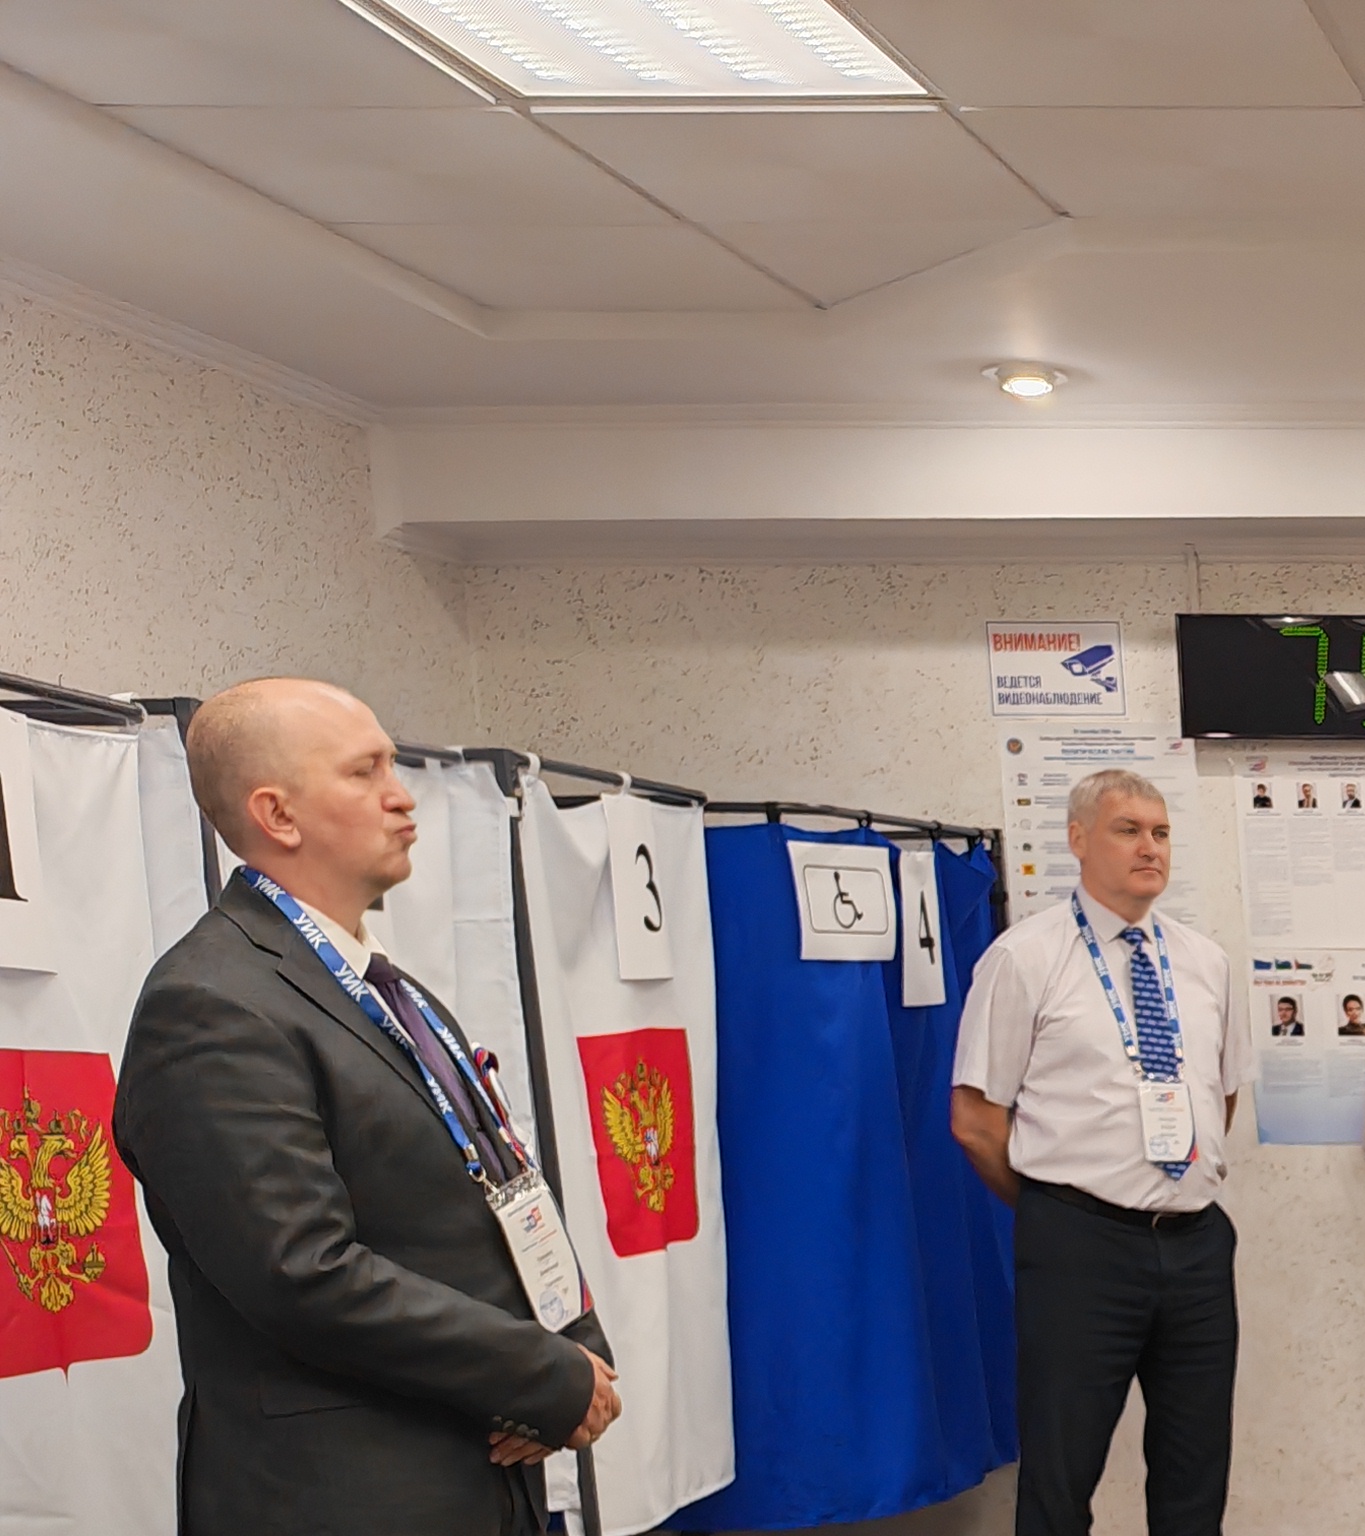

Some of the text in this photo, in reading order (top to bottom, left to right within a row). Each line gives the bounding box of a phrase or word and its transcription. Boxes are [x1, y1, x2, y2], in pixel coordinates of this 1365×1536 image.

[992, 632, 1081, 652] ВНИМАНИЕ!
[996, 675, 1042, 689] ВЕДЕТСЯ
[997, 692, 1102, 706] ВИДЕОНАБЛЮДЕНИЕ
[254, 875, 287, 902] УИК
[636, 843, 663, 932] 3
[294, 912, 329, 950] УИК
[919, 890, 935, 965] 4
[335, 961, 370, 1003] УИК
